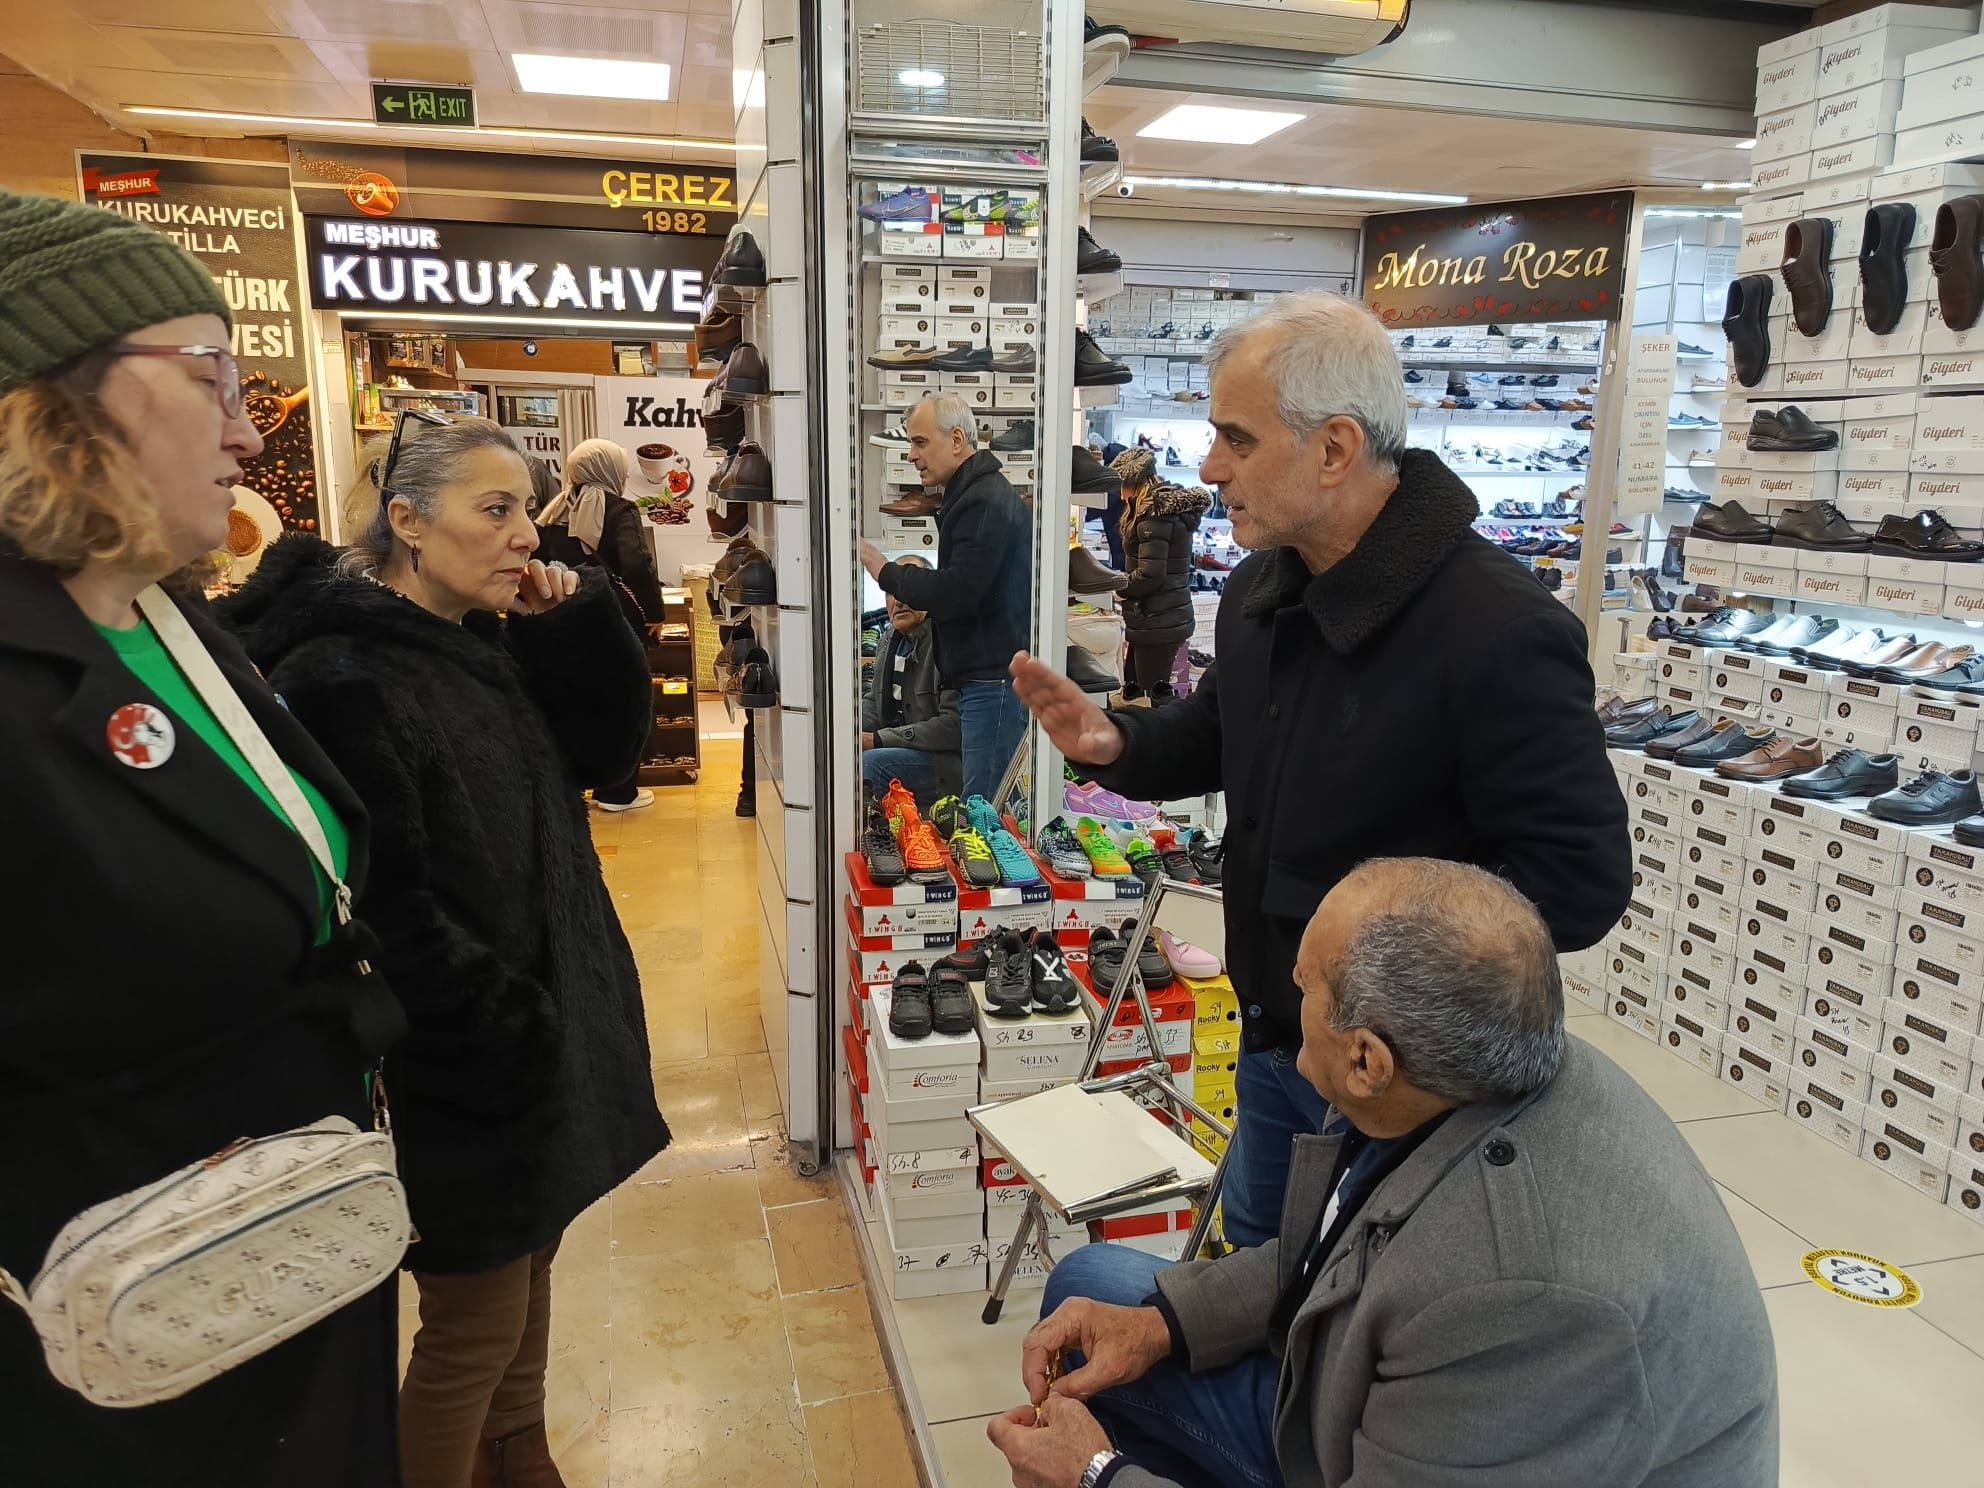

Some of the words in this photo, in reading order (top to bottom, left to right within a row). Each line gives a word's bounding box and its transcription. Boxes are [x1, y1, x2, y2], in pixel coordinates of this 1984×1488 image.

[439, 97, 467, 118] EXIT
[99, 177, 152, 193] MEŞHUR
[601, 170, 732, 208] ÇEREZ
[642, 210, 707, 234] 1982
[155, 228, 241, 254] TİLLA
[324, 222, 440, 248] MEŞHUR
[1374, 244, 1487, 290] Mona
[1498, 241, 1610, 290] Roza
[1641, 343, 1671, 353] ŞEKER
[1856, 366, 1896, 382] Giyderi
[1929, 360, 1973, 377] Giyderi
[623, 396, 704, 428] Kah
[1850, 427, 1889, 442] Giyderi
[1922, 426, 1966, 441] Giyderi
[1760, 479, 1794, 493] Giyderi
[1844, 477, 1883, 492] Giyderi
[1918, 481, 1961, 496] Giyderi
[1742, 571, 1775, 586] Giyderi
[1803, 577, 1841, 592] Giyderi
[1875, 585, 1917, 602] Giyderi
[1197, 1013, 1221, 1025] Rocky
[1196, 1064, 1221, 1074] Rocky
